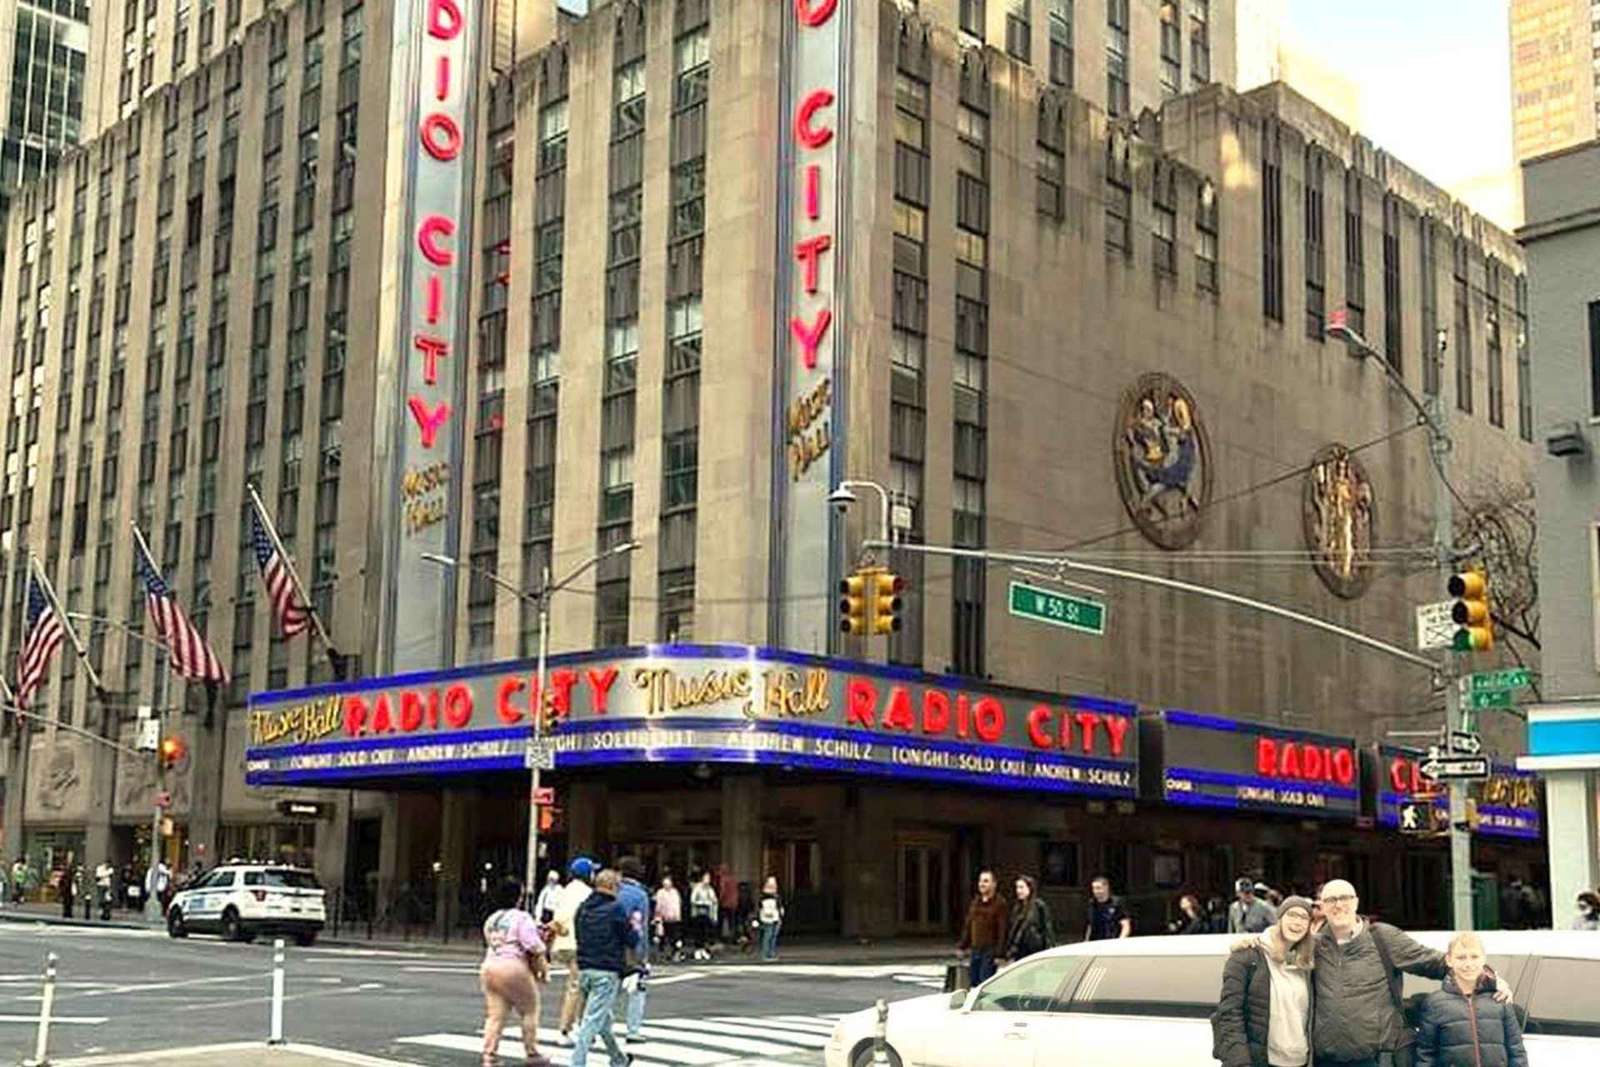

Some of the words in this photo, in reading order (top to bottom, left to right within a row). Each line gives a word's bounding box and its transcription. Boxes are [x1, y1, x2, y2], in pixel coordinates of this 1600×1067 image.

[788, 89, 836, 371] CITY
[407, 215, 457, 449] CITY
[343, 687, 474, 738] RADIO
[632, 666, 752, 716] Music
[742, 664, 830, 718] Hall
[845, 676, 1006, 742] RADIO
[1028, 702, 1129, 758] CITY
[1257, 736, 1353, 786] RADIO
